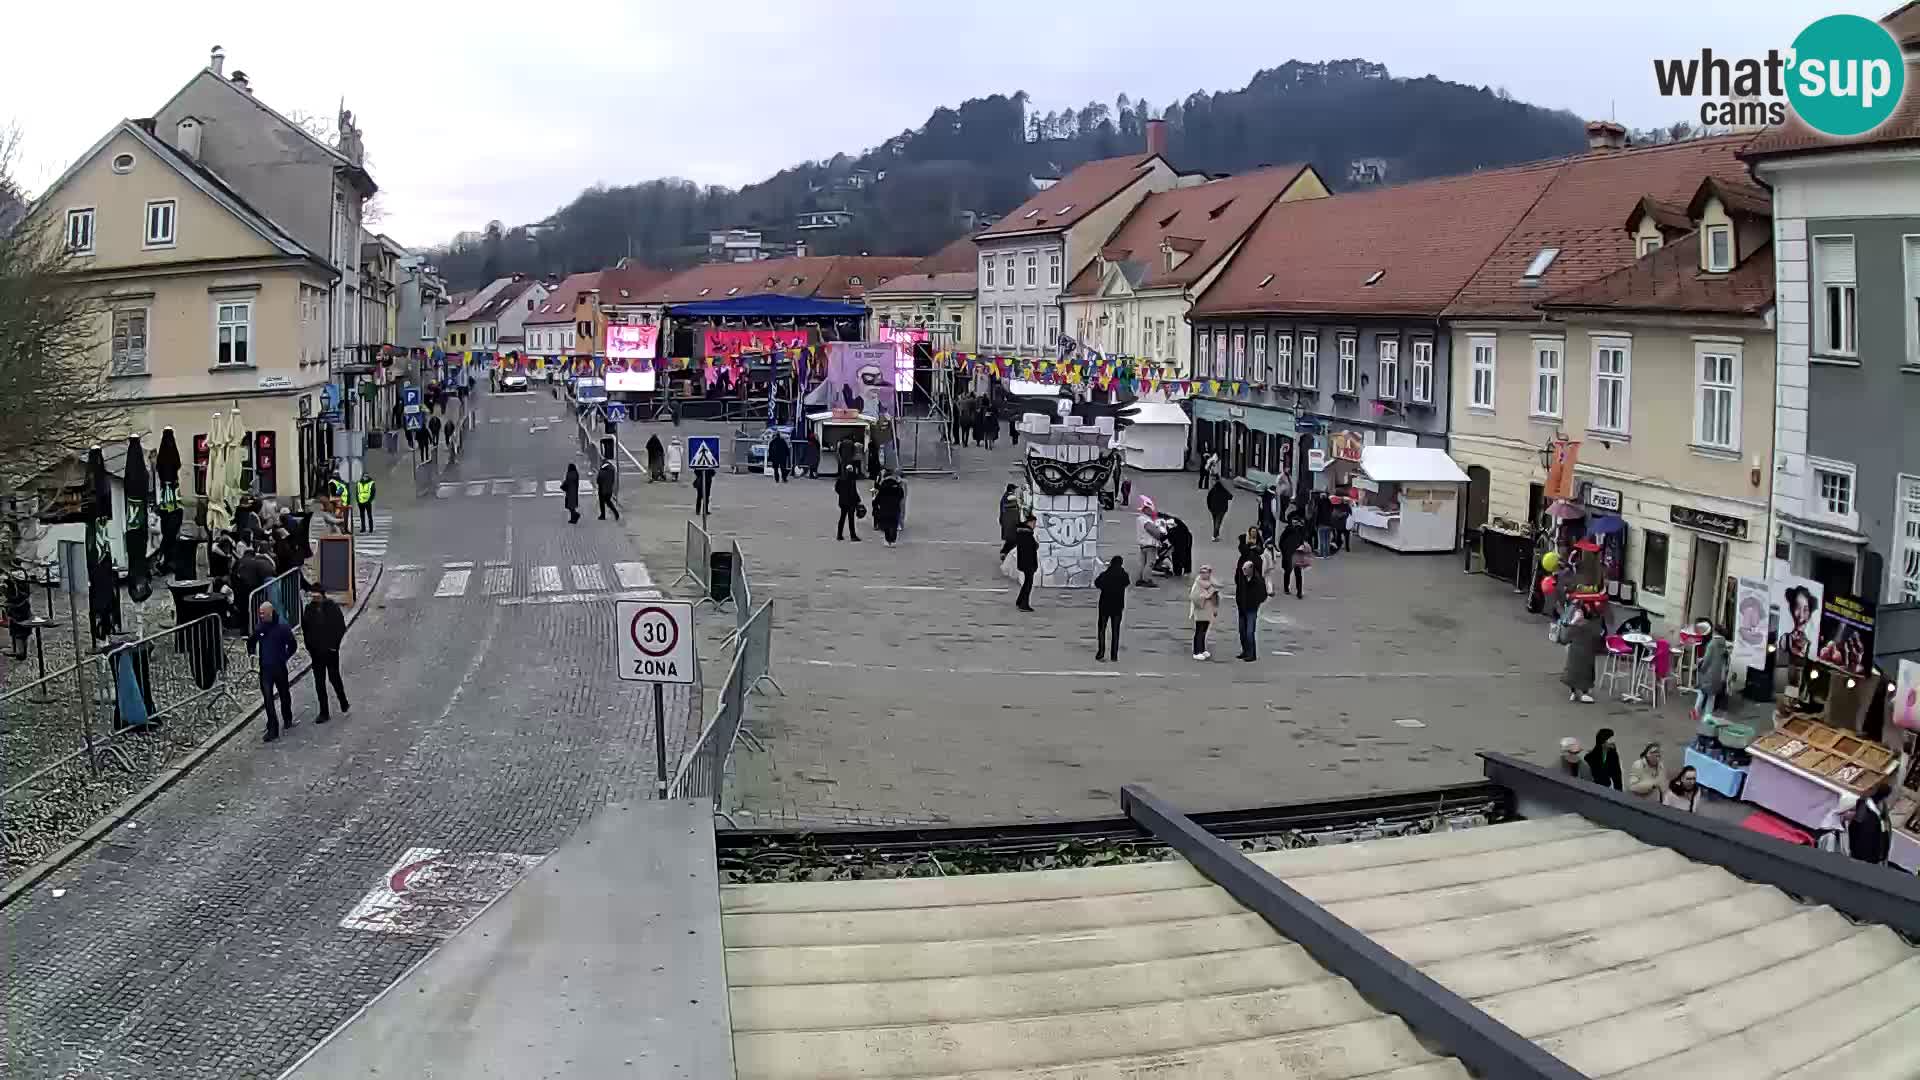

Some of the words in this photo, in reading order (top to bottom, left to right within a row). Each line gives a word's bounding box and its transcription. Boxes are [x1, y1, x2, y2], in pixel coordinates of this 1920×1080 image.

[407, 391, 416, 402] P
[643, 622, 667, 643] 30
[633, 659, 678, 676] ZONA
